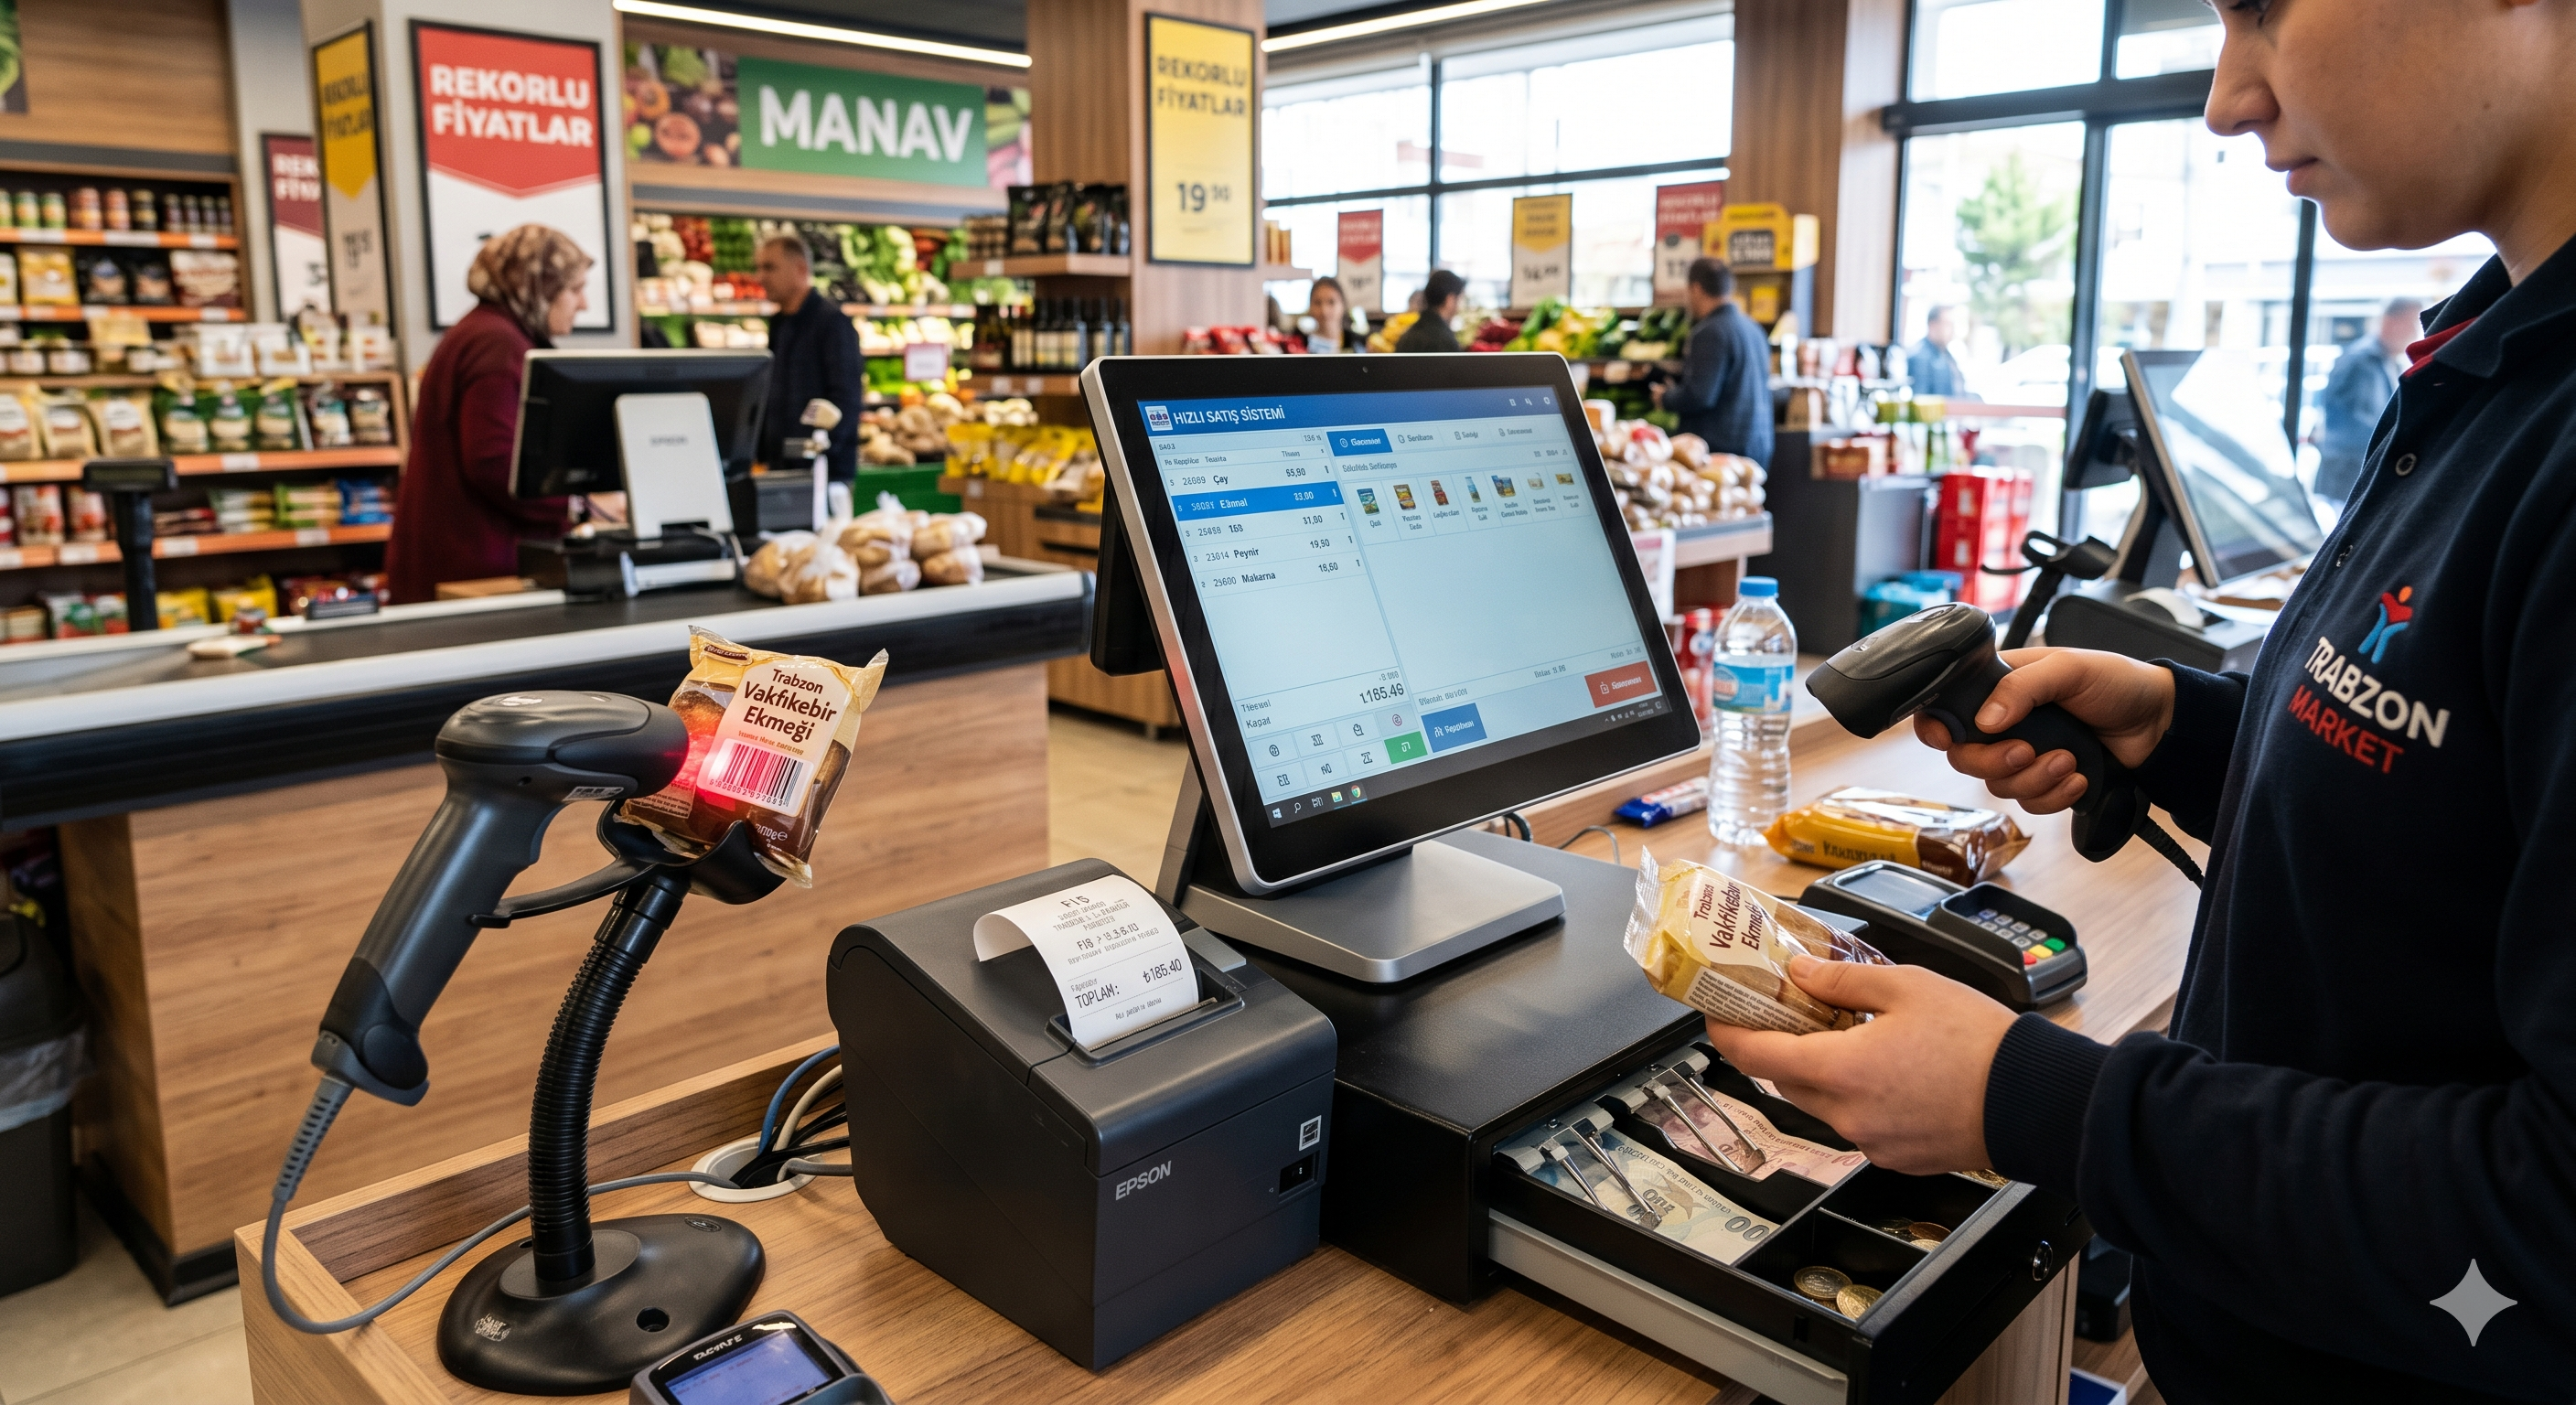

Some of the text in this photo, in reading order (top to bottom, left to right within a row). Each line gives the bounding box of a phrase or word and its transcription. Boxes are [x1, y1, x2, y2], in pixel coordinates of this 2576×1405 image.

[429, 63, 591, 111] REKORLU
[1156, 56, 1248, 87] REKORLU
[432, 97, 594, 148] FİYATLAR
[759, 85, 973, 163] MANAV
[1173, 410, 1206, 425] HIZLI
[1207, 409, 1240, 424] SATIŞ
[1241, 404, 1286, 422] SİSTEMİ
[1233, 547, 1260, 560] Peynir
[1240, 572, 1276, 584] Makarna
[772, 668, 824, 695] Trabzon
[2304, 636, 2452, 749] TRABZON
[743, 705, 816, 744] Ekmeği
[2287, 684, 2406, 775] MARKET
[1074, 982, 1121, 1009] TOPLAM:
[1115, 1160, 1172, 1201] EPSON
